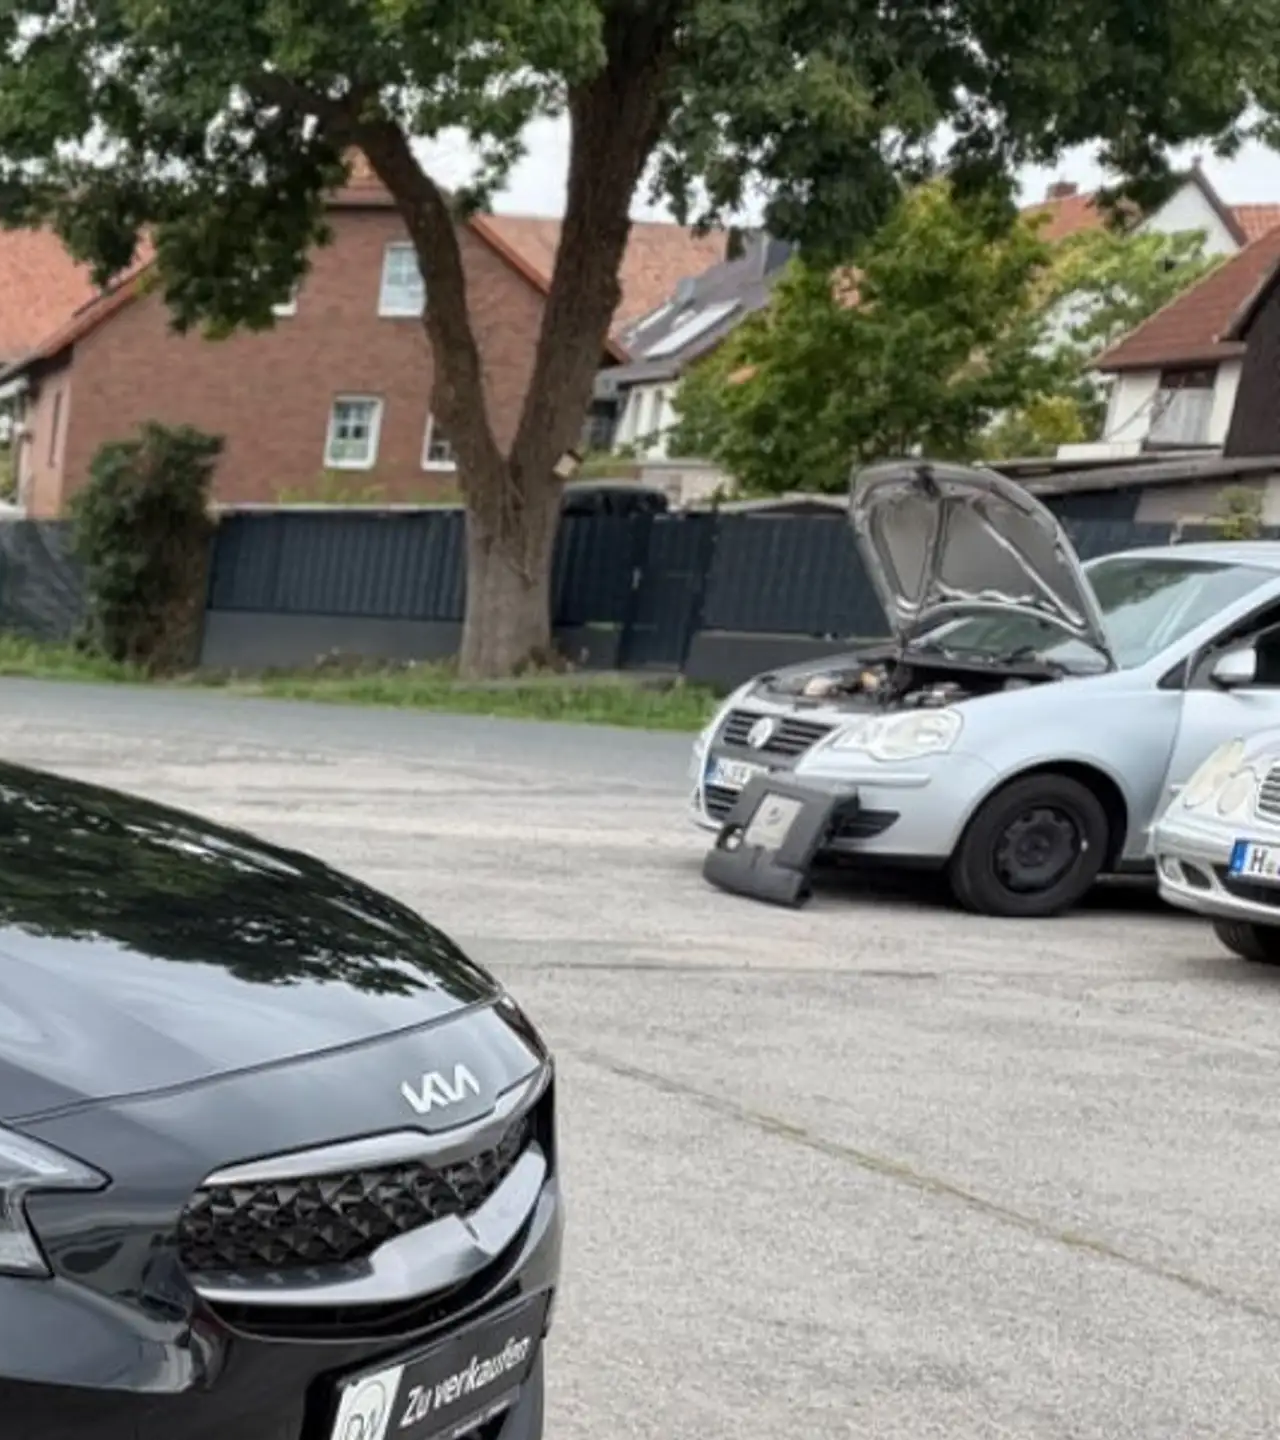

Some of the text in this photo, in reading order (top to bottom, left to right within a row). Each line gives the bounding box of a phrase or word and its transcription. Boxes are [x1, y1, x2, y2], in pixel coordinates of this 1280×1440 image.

[401, 1064, 480, 1113] KIA
[400, 1336, 530, 1428] Zu verkaufen
